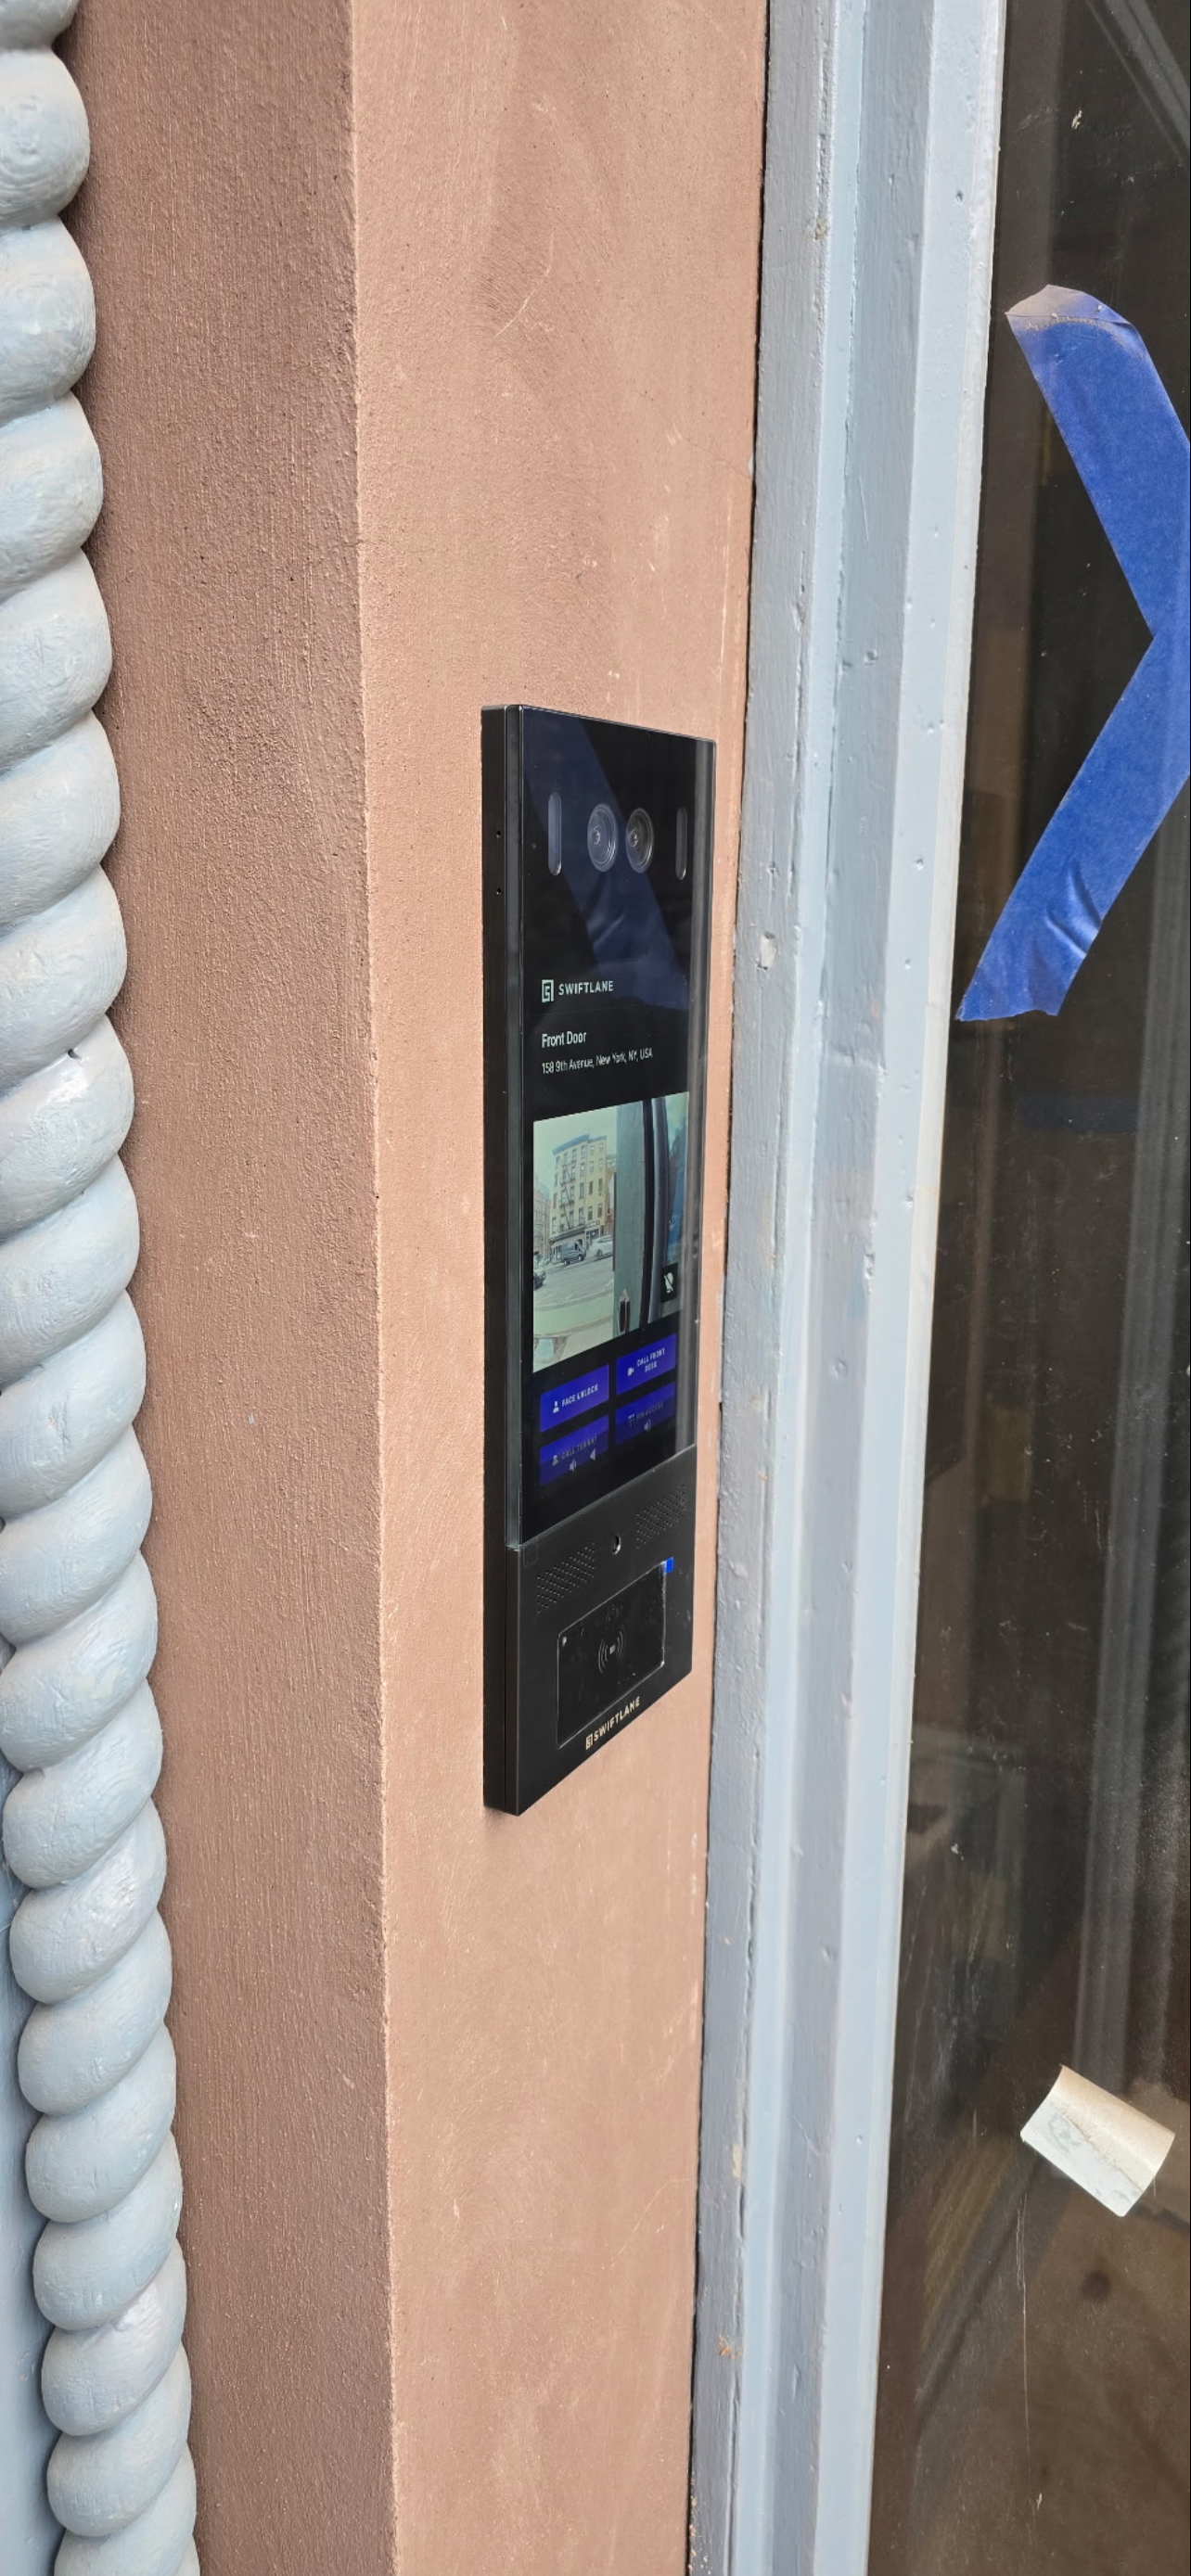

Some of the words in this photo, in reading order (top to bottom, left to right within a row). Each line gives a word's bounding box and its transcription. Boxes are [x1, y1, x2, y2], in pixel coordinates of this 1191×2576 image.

[558, 980, 614, 996] SWIFTLANE
[542, 1032, 565, 1048] Front
[566, 1030, 587, 1045] Door
[556, 1060, 568, 1072] 9th
[569, 1058, 595, 1070] Avenue,
[596, 1054, 611, 1066] New
[612, 1052, 627, 1064] York,
[628, 1050, 639, 1063] NY,
[639, 1047, 653, 1060] USA
[561, 1394, 576, 1407] FACE
[594, 1696, 640, 1741] SWIFTLANE
